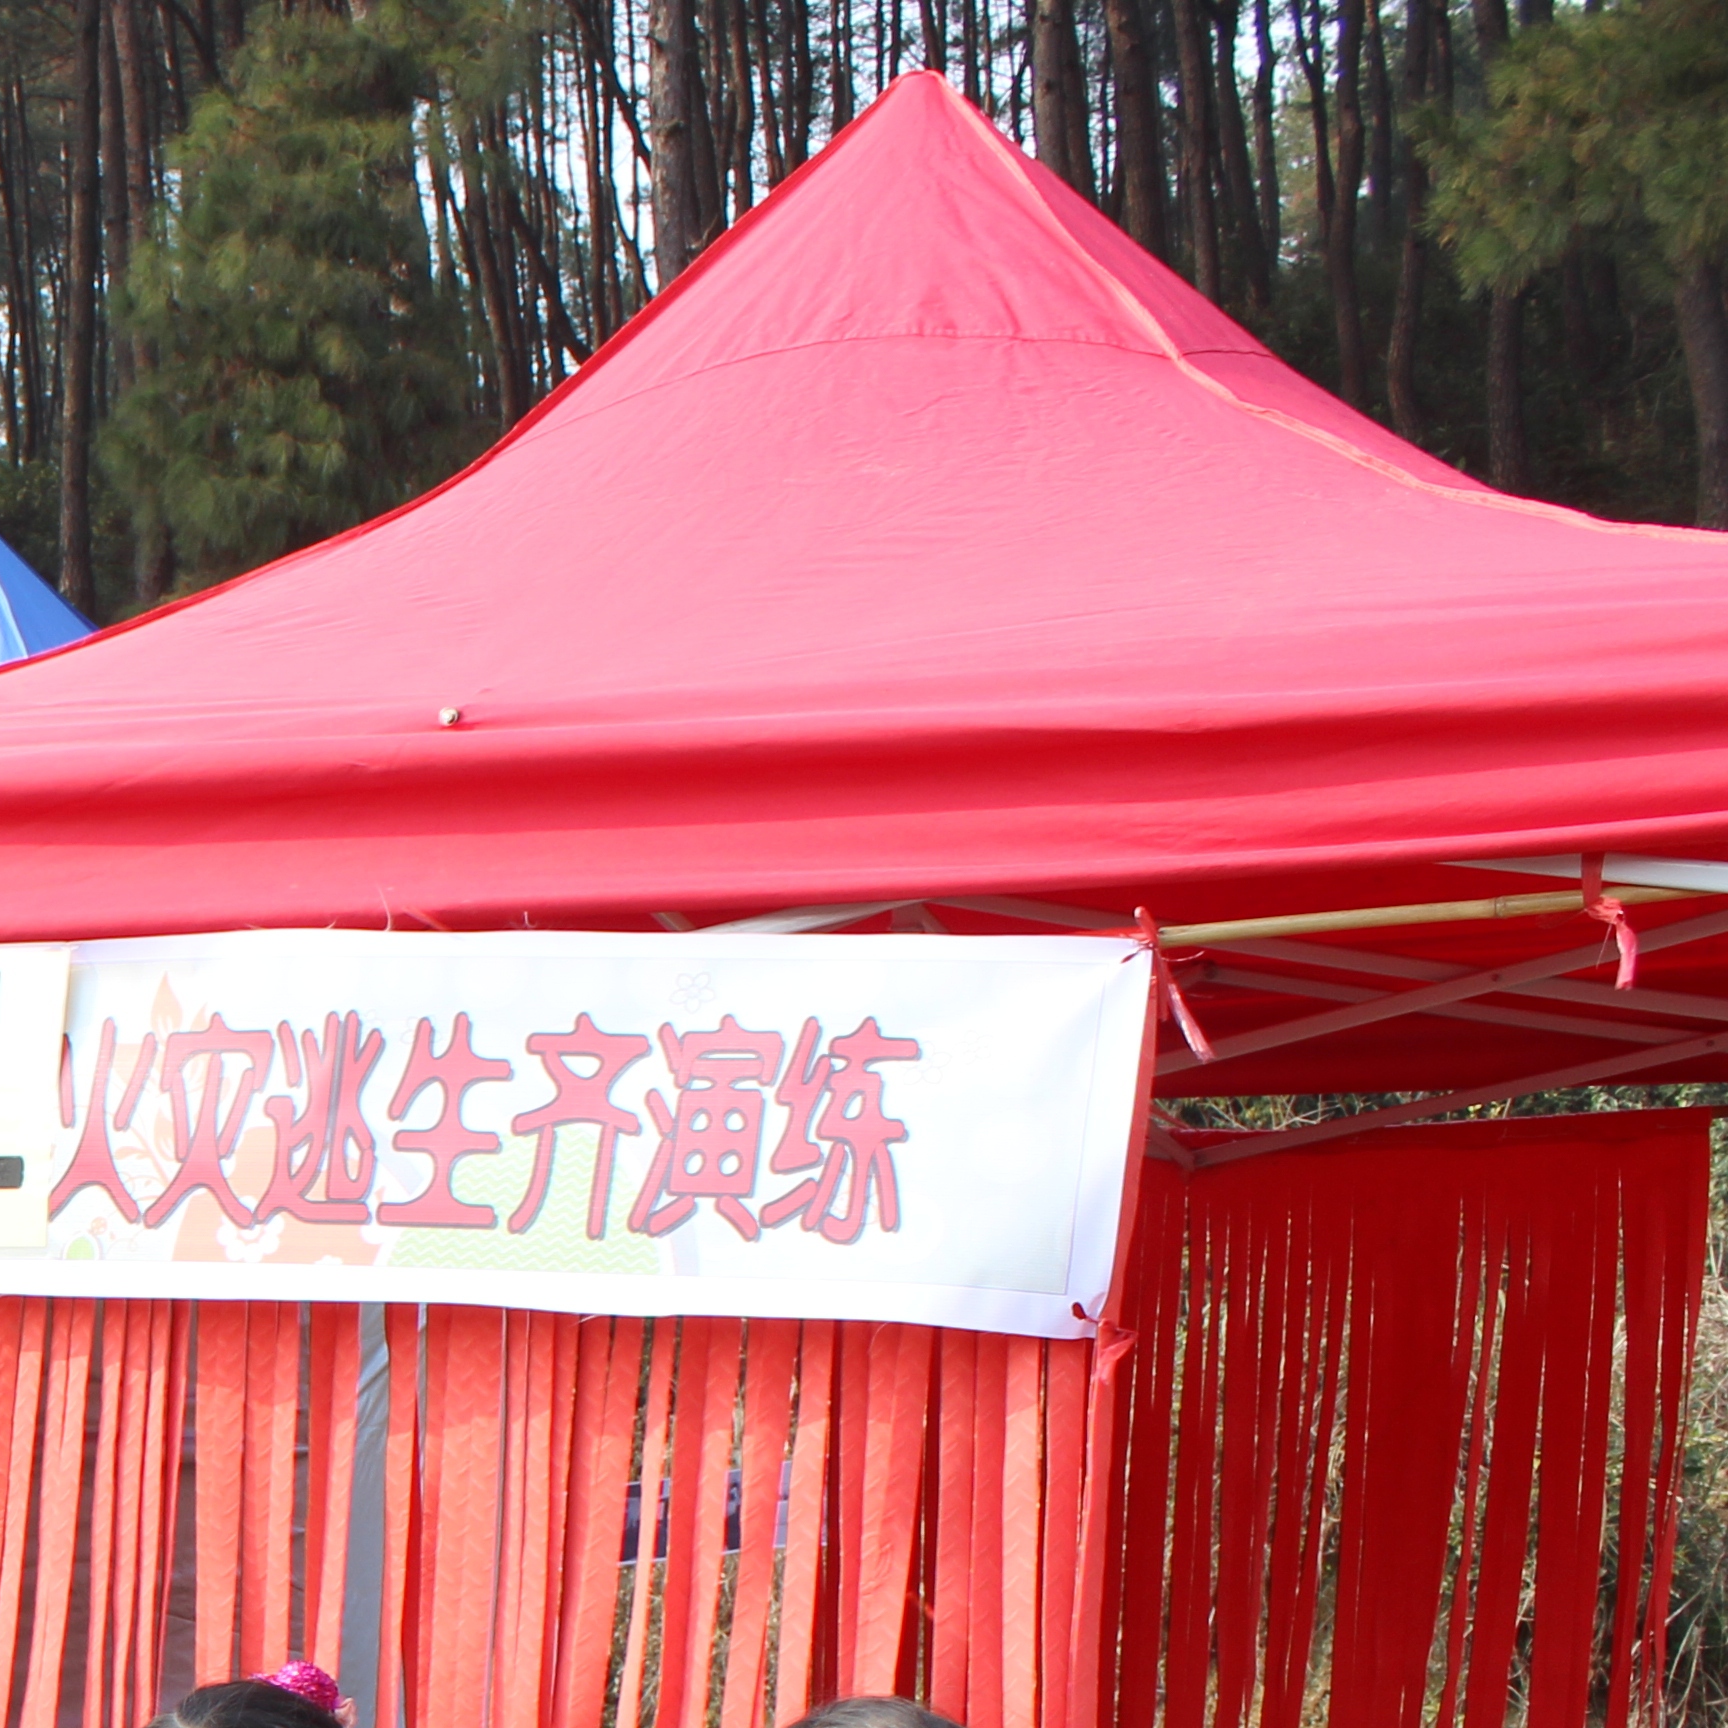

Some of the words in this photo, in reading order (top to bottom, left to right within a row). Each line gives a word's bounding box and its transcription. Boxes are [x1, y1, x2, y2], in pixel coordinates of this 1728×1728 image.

[48, 1008, 920, 1244] 火灾逃生齐演练
